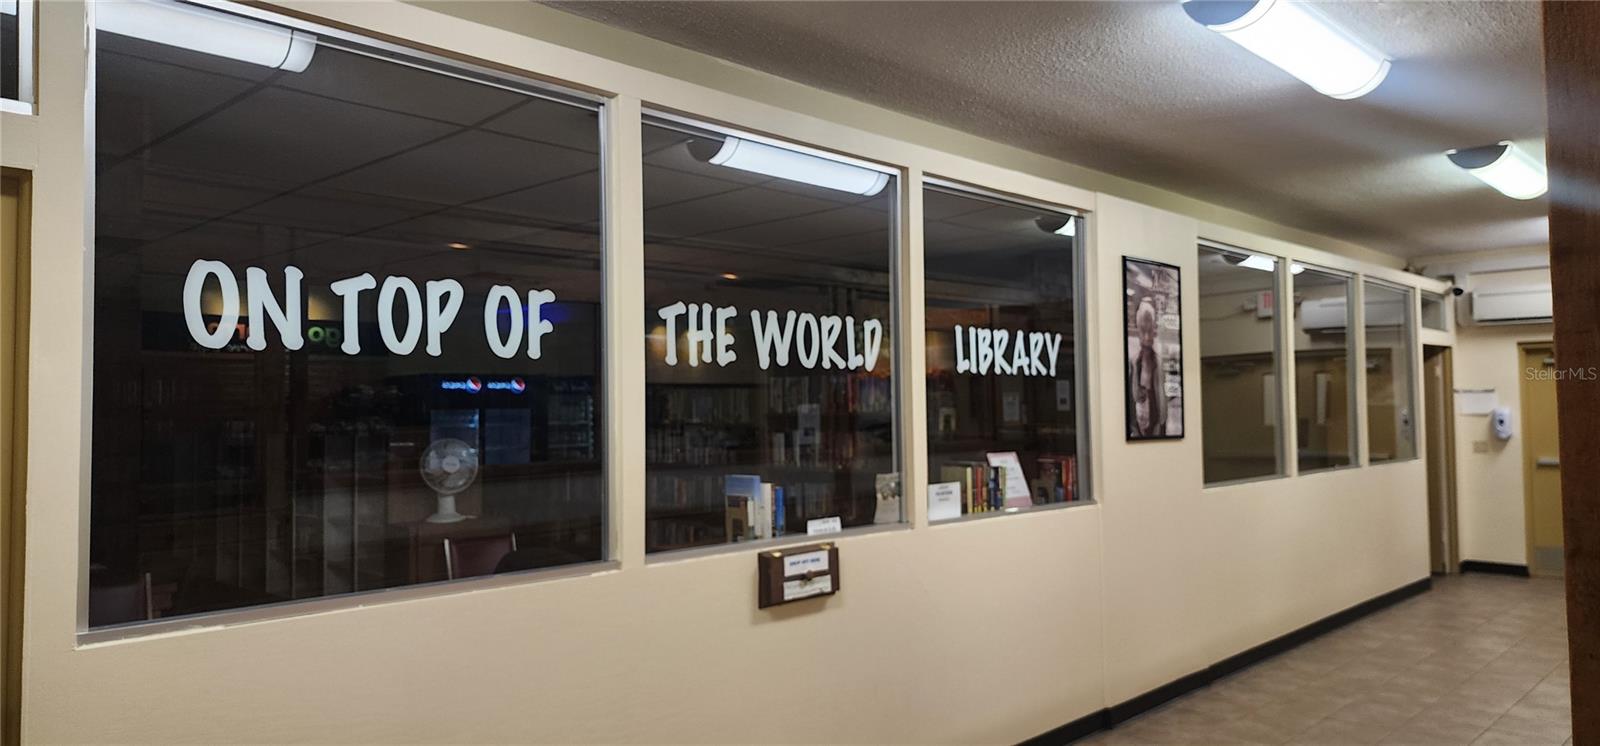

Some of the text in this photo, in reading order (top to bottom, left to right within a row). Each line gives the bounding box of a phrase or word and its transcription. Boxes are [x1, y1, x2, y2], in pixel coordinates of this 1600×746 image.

[183, 259, 555, 359] ON TOP OF
[658, 302, 882, 371] THE WORLD
[955, 325, 1061, 376] LIBRARY
